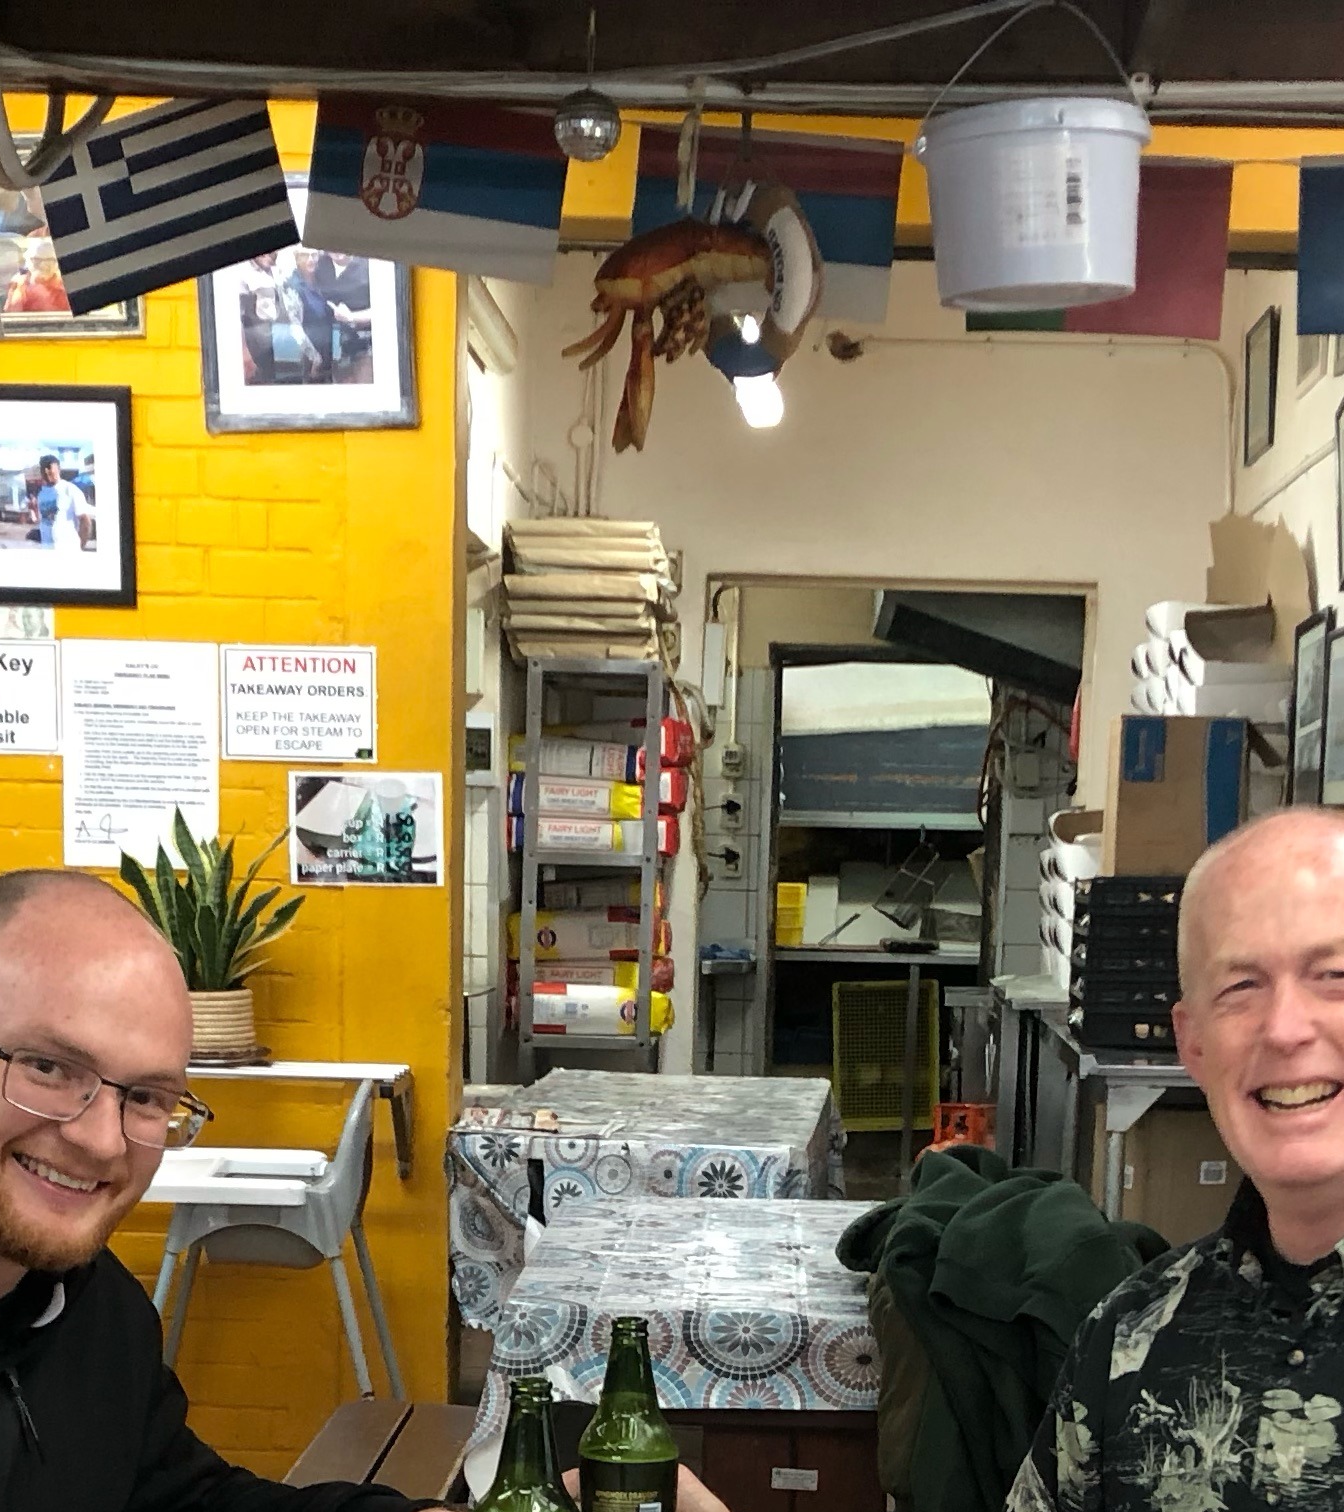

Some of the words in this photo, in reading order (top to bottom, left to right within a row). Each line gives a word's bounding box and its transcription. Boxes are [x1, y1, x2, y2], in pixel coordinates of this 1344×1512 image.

[242, 655, 356, 674] ATTENTION
[230, 683, 303, 696] TAKEAWAY
[236, 711, 268, 722] KEEP
[272, 711, 294, 722] THE
[299, 712, 361, 723] TAKEAWAY
[236, 724, 270, 736] OPEN
[273, 725, 298, 736] FOR
[302, 726, 343, 737] STEAM
[347, 727, 363, 738] TO
[275, 739, 323, 751] ESCAPE
[544, 786, 570, 796] FAIRY
[571, 788, 598, 798] LIGHT
[547, 824, 573, 833] FAIRY
[574, 825, 601, 835] LIGHT
[326, 847, 363, 858] carrier
[301, 862, 335, 875] paper
[336, 861, 363, 875] plate
